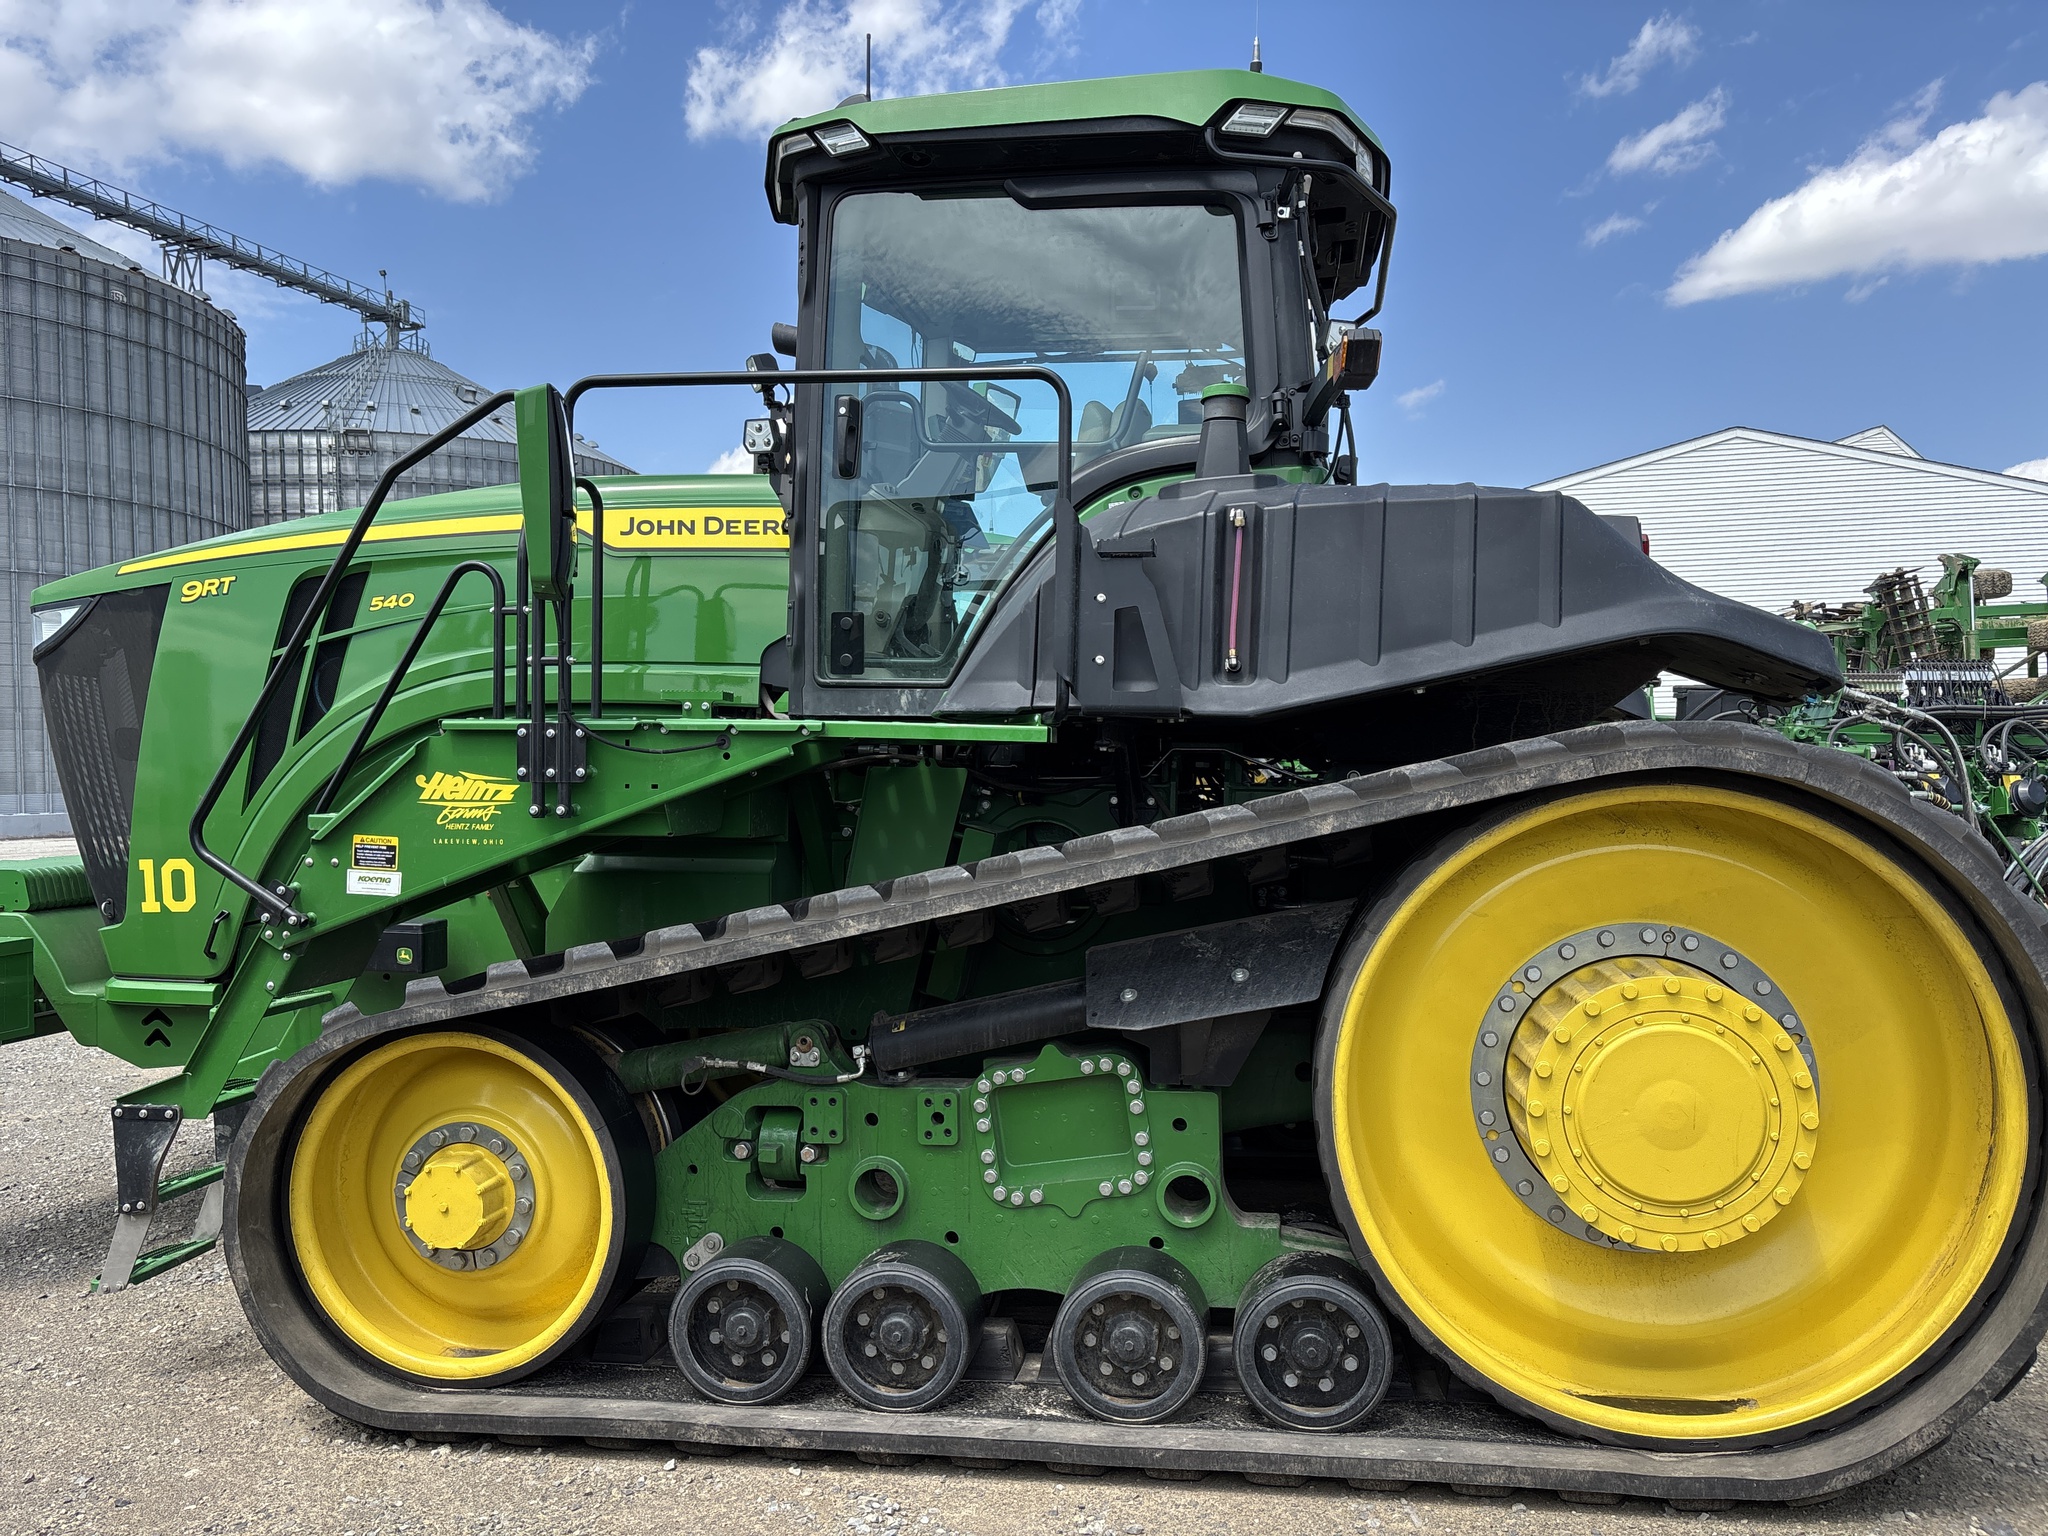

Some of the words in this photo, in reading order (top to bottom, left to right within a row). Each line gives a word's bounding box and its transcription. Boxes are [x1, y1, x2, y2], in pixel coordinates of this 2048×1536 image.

[620, 517, 696, 536] JOHN
[180, 576, 237, 603] 9RT
[368, 592, 416, 612] 540
[445, 823, 470, 831] HEINTZ
[471, 823, 495, 831] FAMILY
[365, 836, 392, 845] CAUTION
[433, 838, 481, 846] LAKEVIEW,
[483, 838, 504, 846] OHIO
[138, 858, 197, 913] 10
